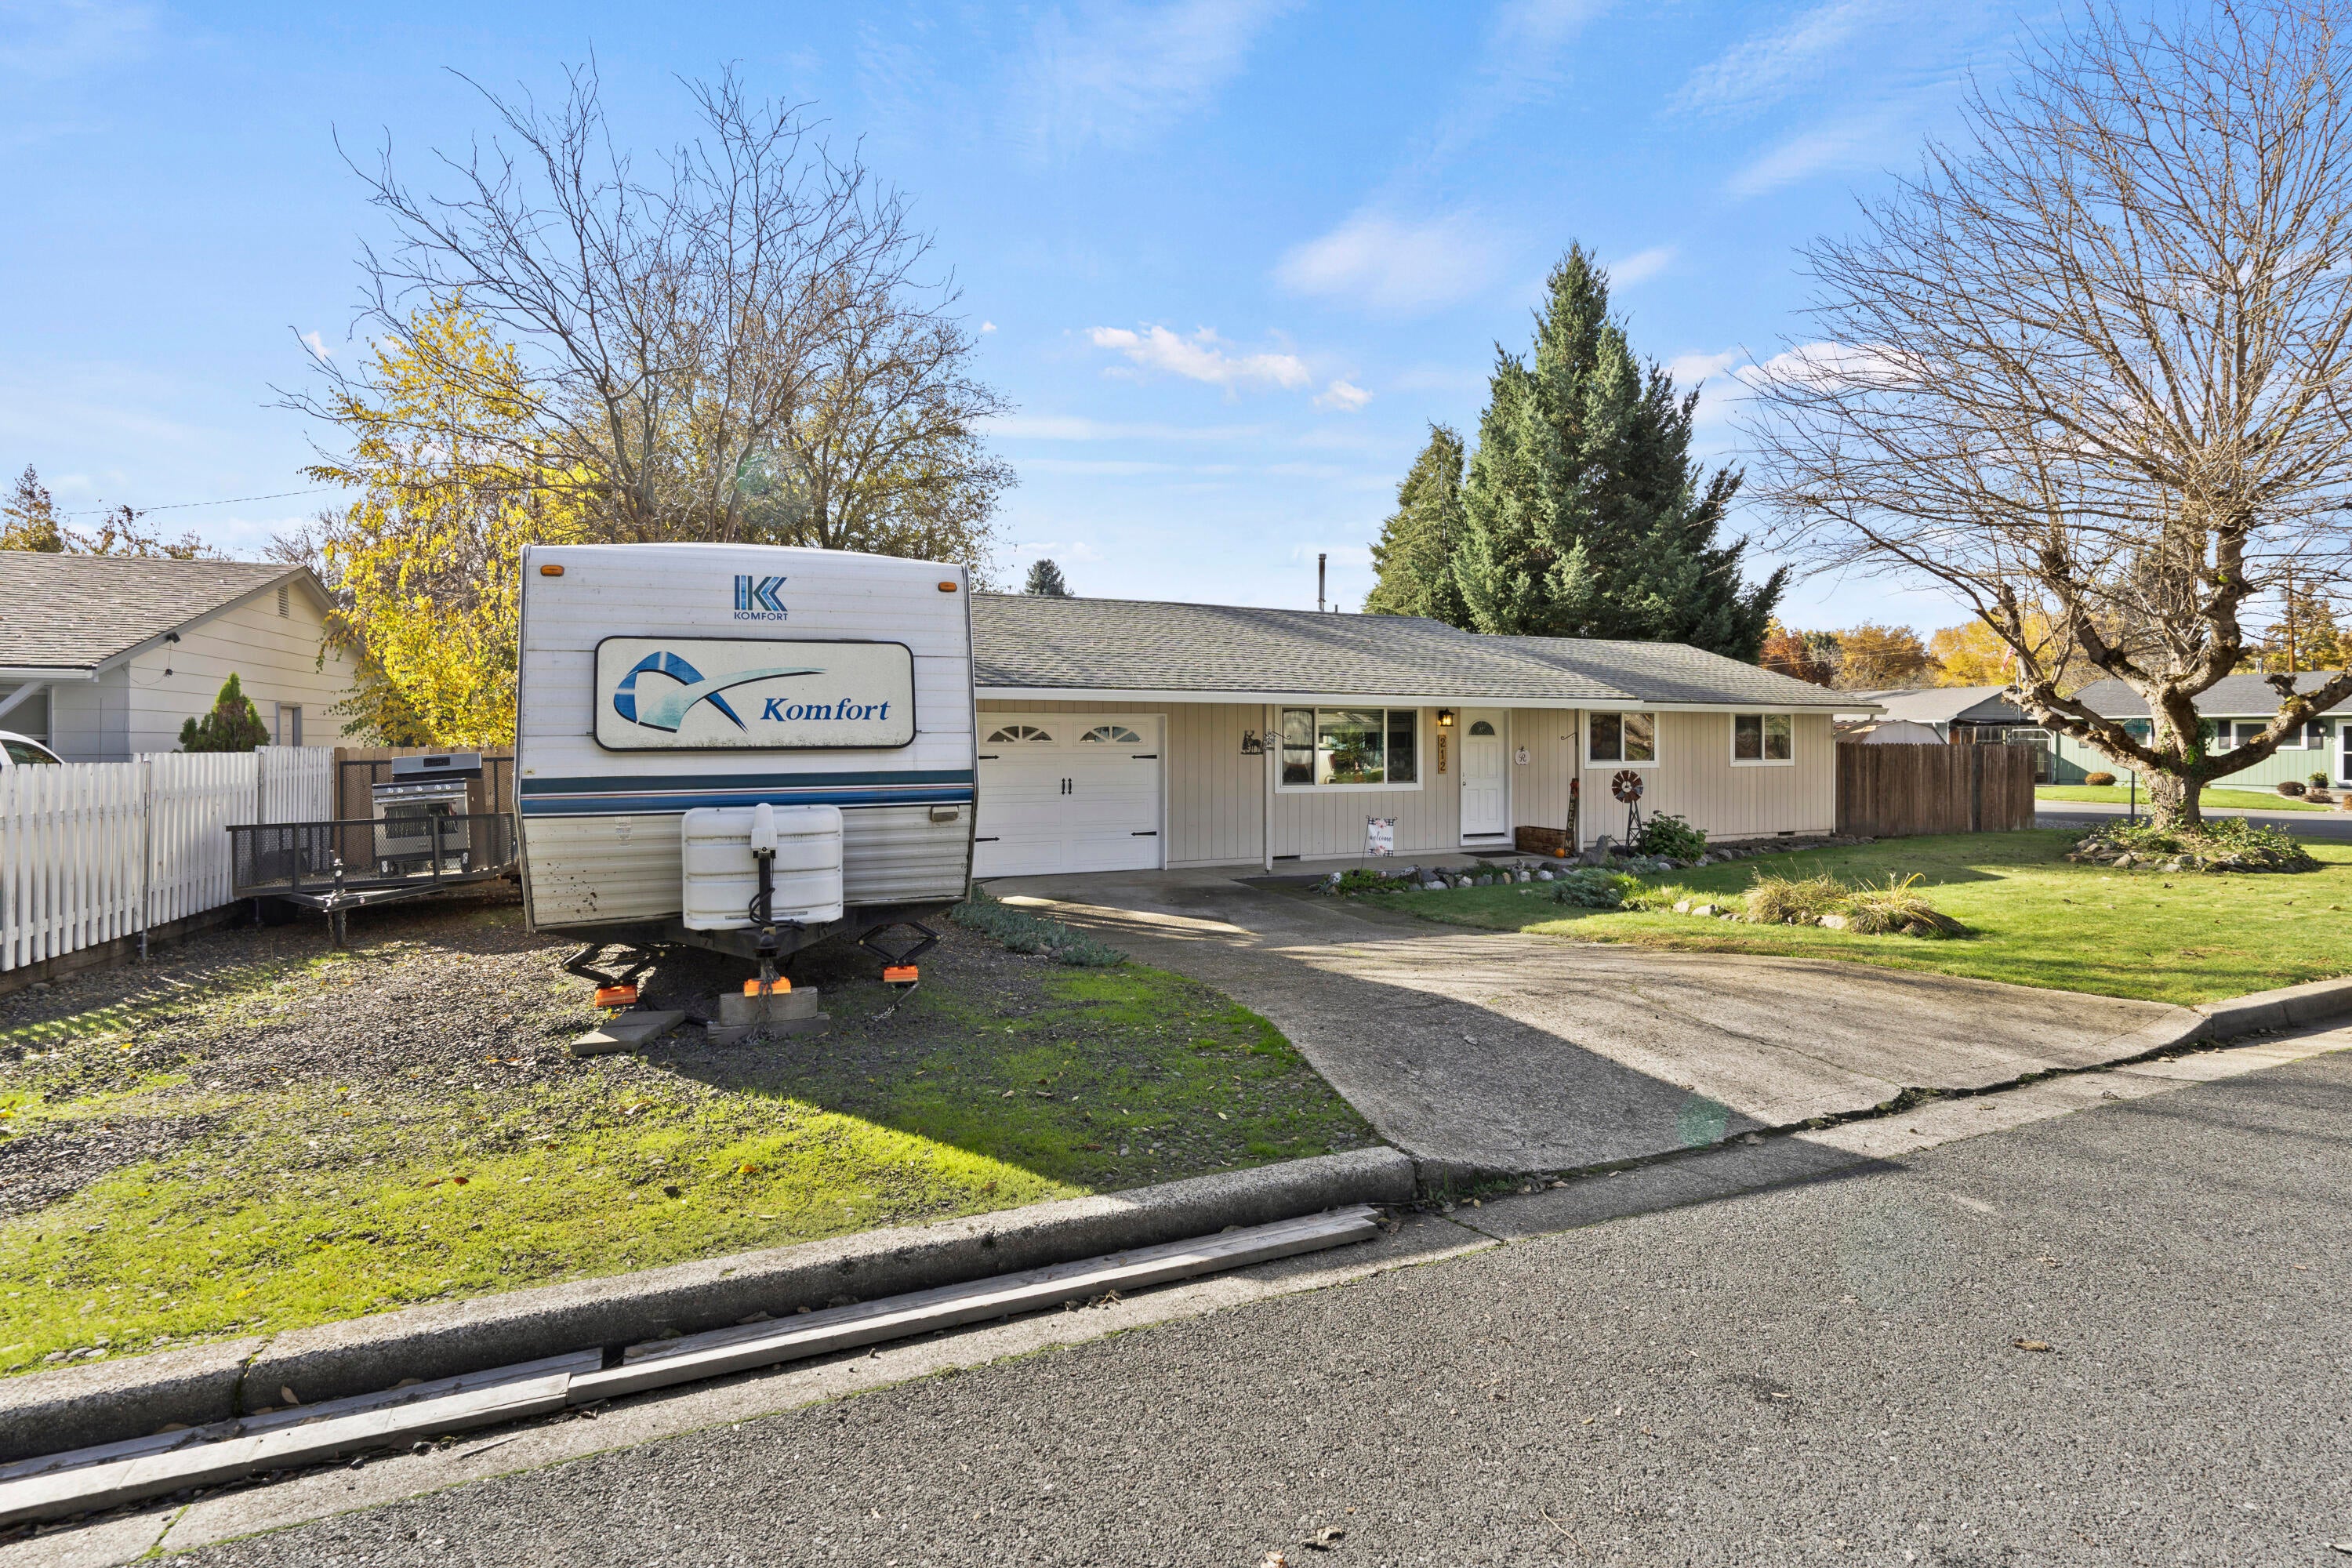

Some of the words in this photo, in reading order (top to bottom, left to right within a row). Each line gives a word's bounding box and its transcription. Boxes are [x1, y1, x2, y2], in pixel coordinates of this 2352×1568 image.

[734, 612, 788, 621] KOMFORT
[760, 698, 891, 722] Komfort
[1519, 753, 1527, 762] R
[1565, 793, 1575, 858] WELCME
[1369, 830, 1392, 842] welcome
